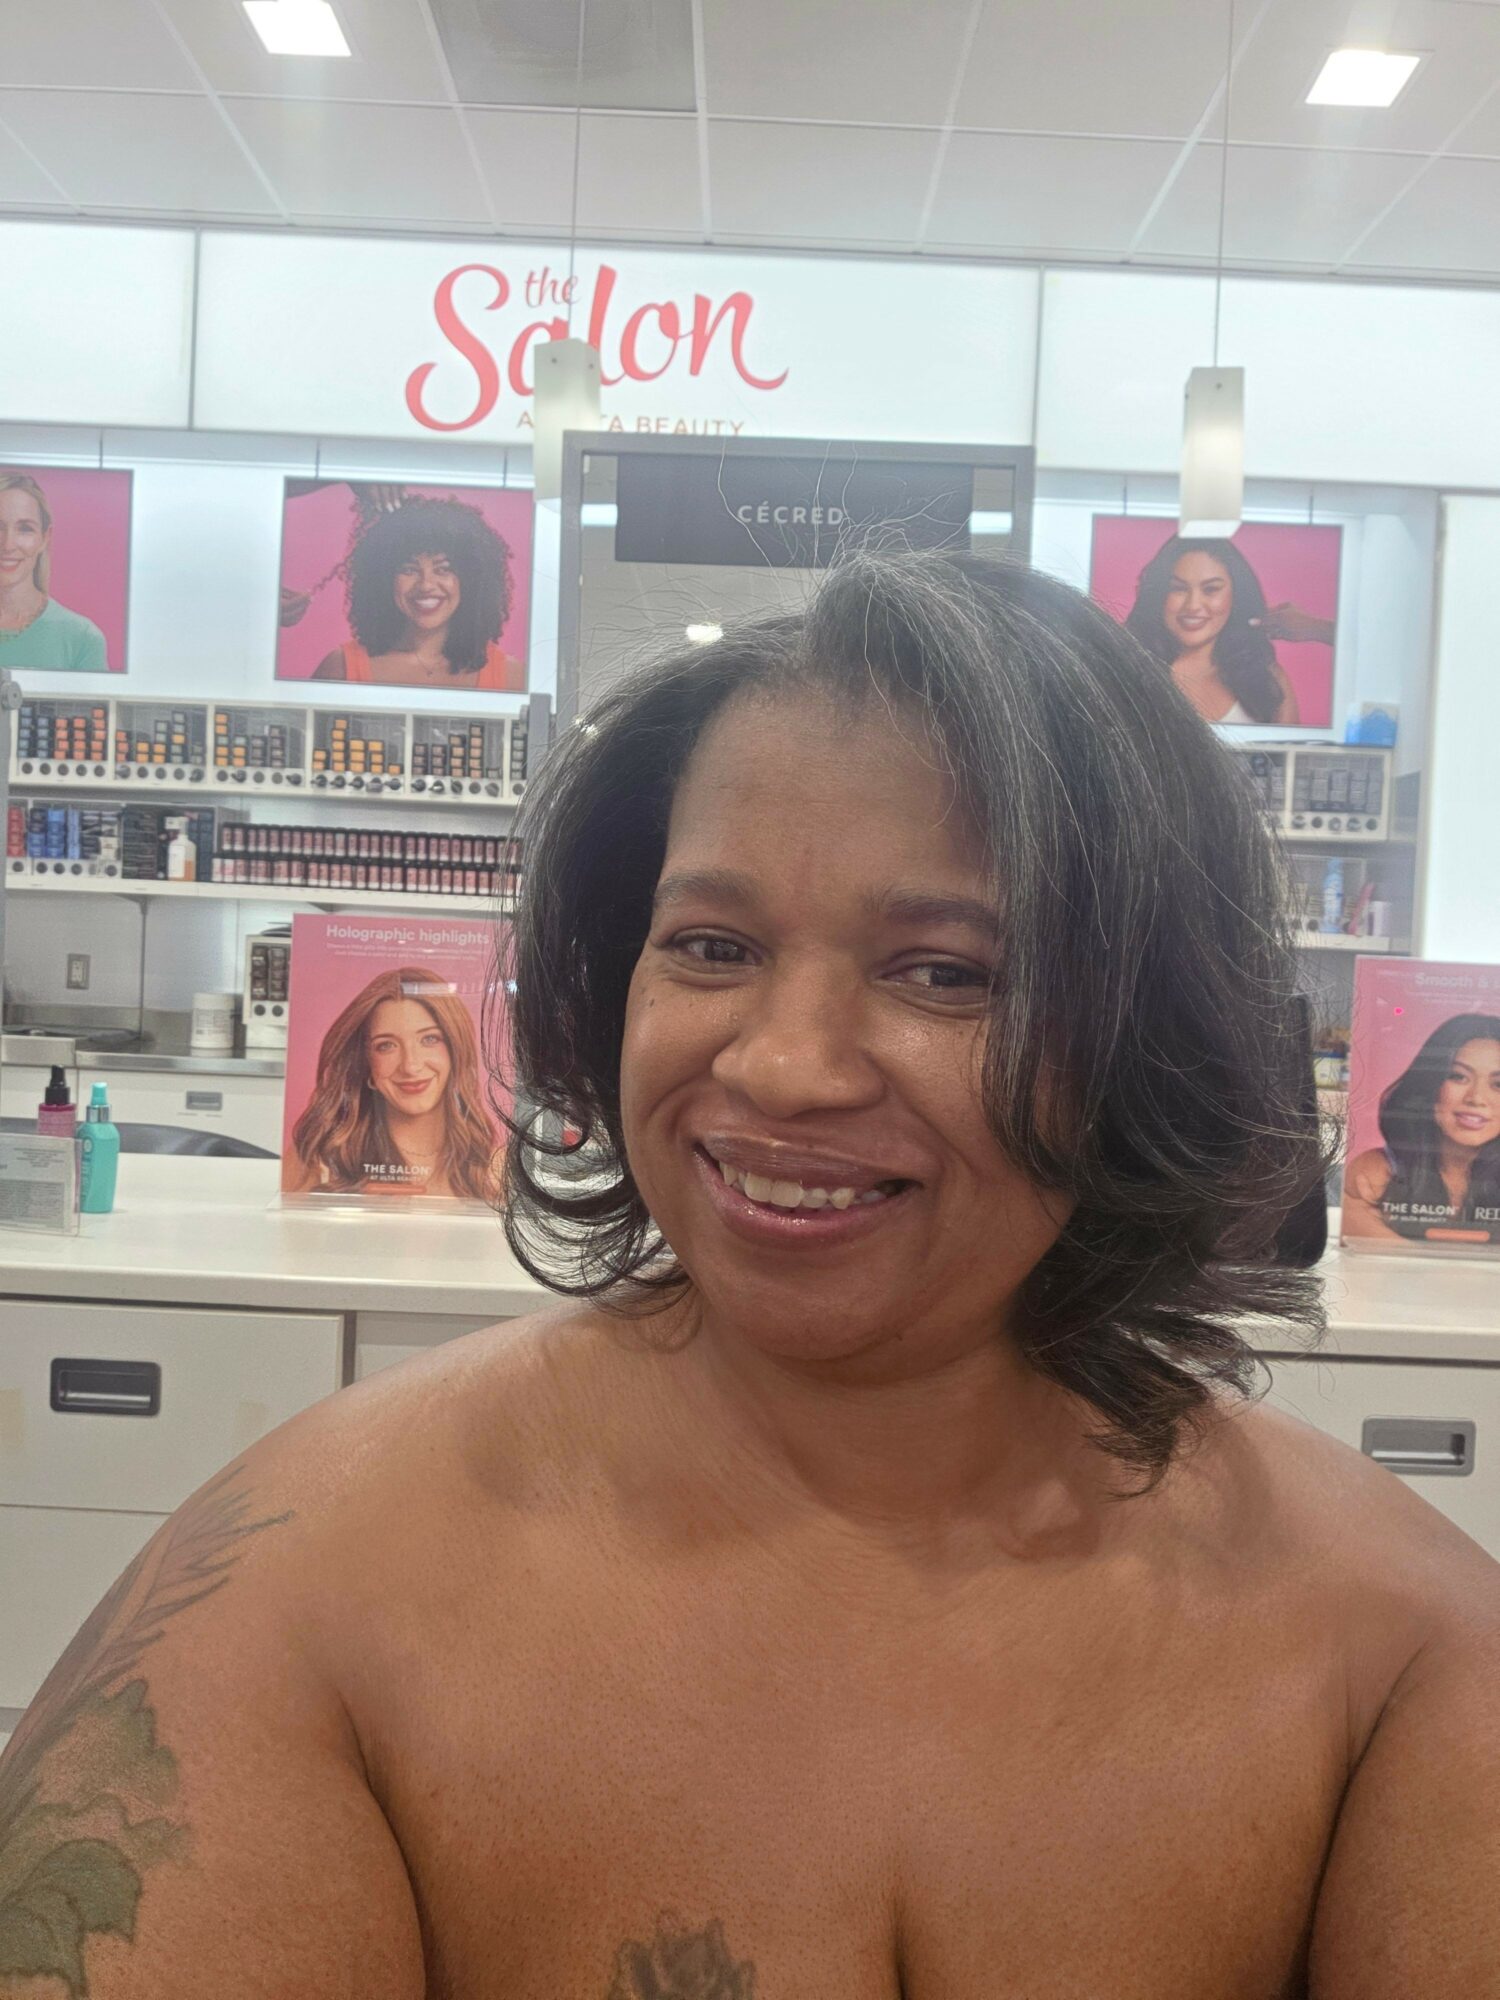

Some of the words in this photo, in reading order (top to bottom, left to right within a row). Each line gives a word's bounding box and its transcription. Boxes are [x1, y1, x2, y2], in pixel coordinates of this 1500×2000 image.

[524, 266, 580, 308] the
[404, 263, 790, 433] Salon
[635, 415, 745, 437] BEAUTY
[737, 500, 844, 526] CÉCRED
[326, 924, 415, 942] Holographic
[419, 929, 490, 945] highlights
[363, 1163, 386, 1174] THE
[389, 1164, 429, 1176] SALON
[1382, 1201, 1408, 1214] THE
[1411, 1203, 1456, 1216] SALON
